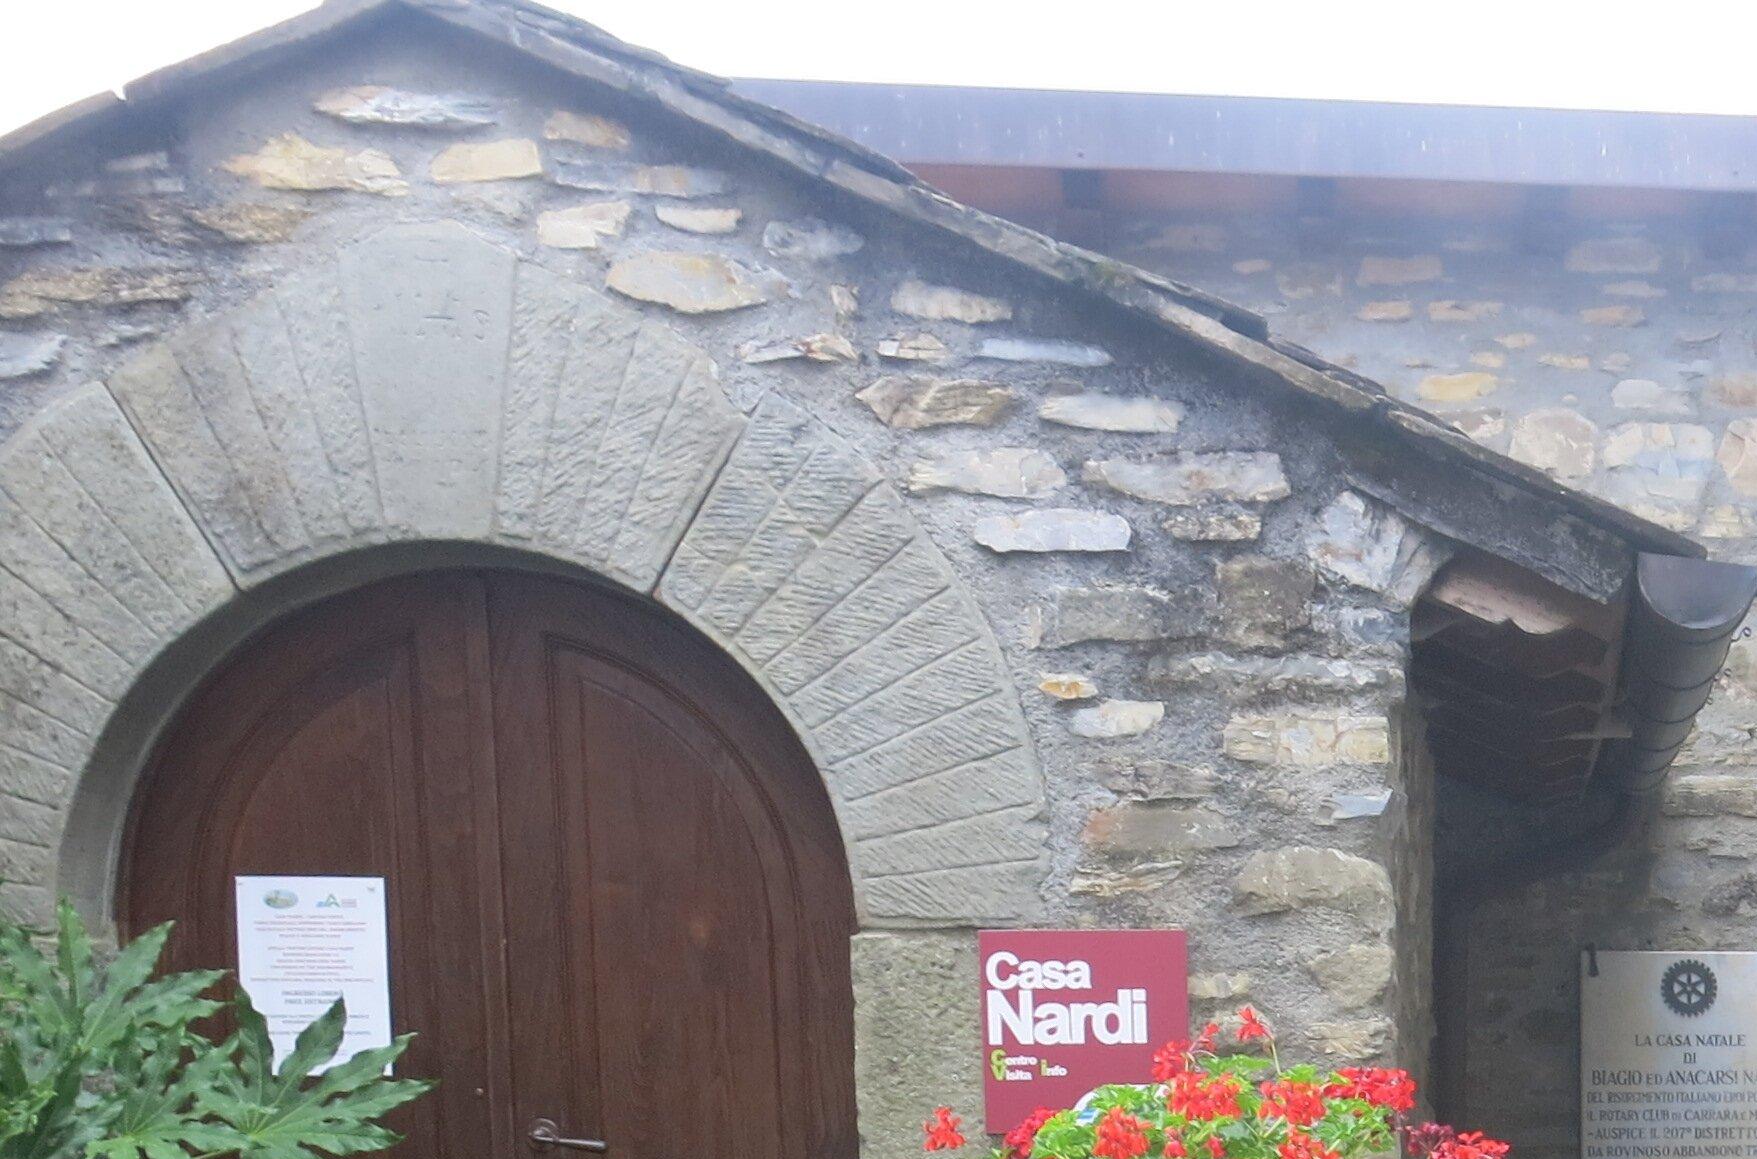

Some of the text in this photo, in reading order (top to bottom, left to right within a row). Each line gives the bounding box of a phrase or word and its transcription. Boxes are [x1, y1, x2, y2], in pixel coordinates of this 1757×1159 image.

[985, 951, 1092, 990] Casa
[986, 988, 1148, 1045] Nardi
[1635, 1034, 1746, 1047] LA CASA NATALE
[1683, 1052, 1697, 1064] DI
[1592, 1070, 1642, 1085] BIAGIO
[1646, 1073, 1663, 1085] ED
[1665, 1070, 1738, 1085] ANACARSI
[1600, 1109, 1639, 1121] ROTARY
[1643, 1109, 1669, 1121] CLUB
[1684, 1109, 1739, 1121] CARRARA
[1606, 1145, 1670, 1157] ROVINOSO
